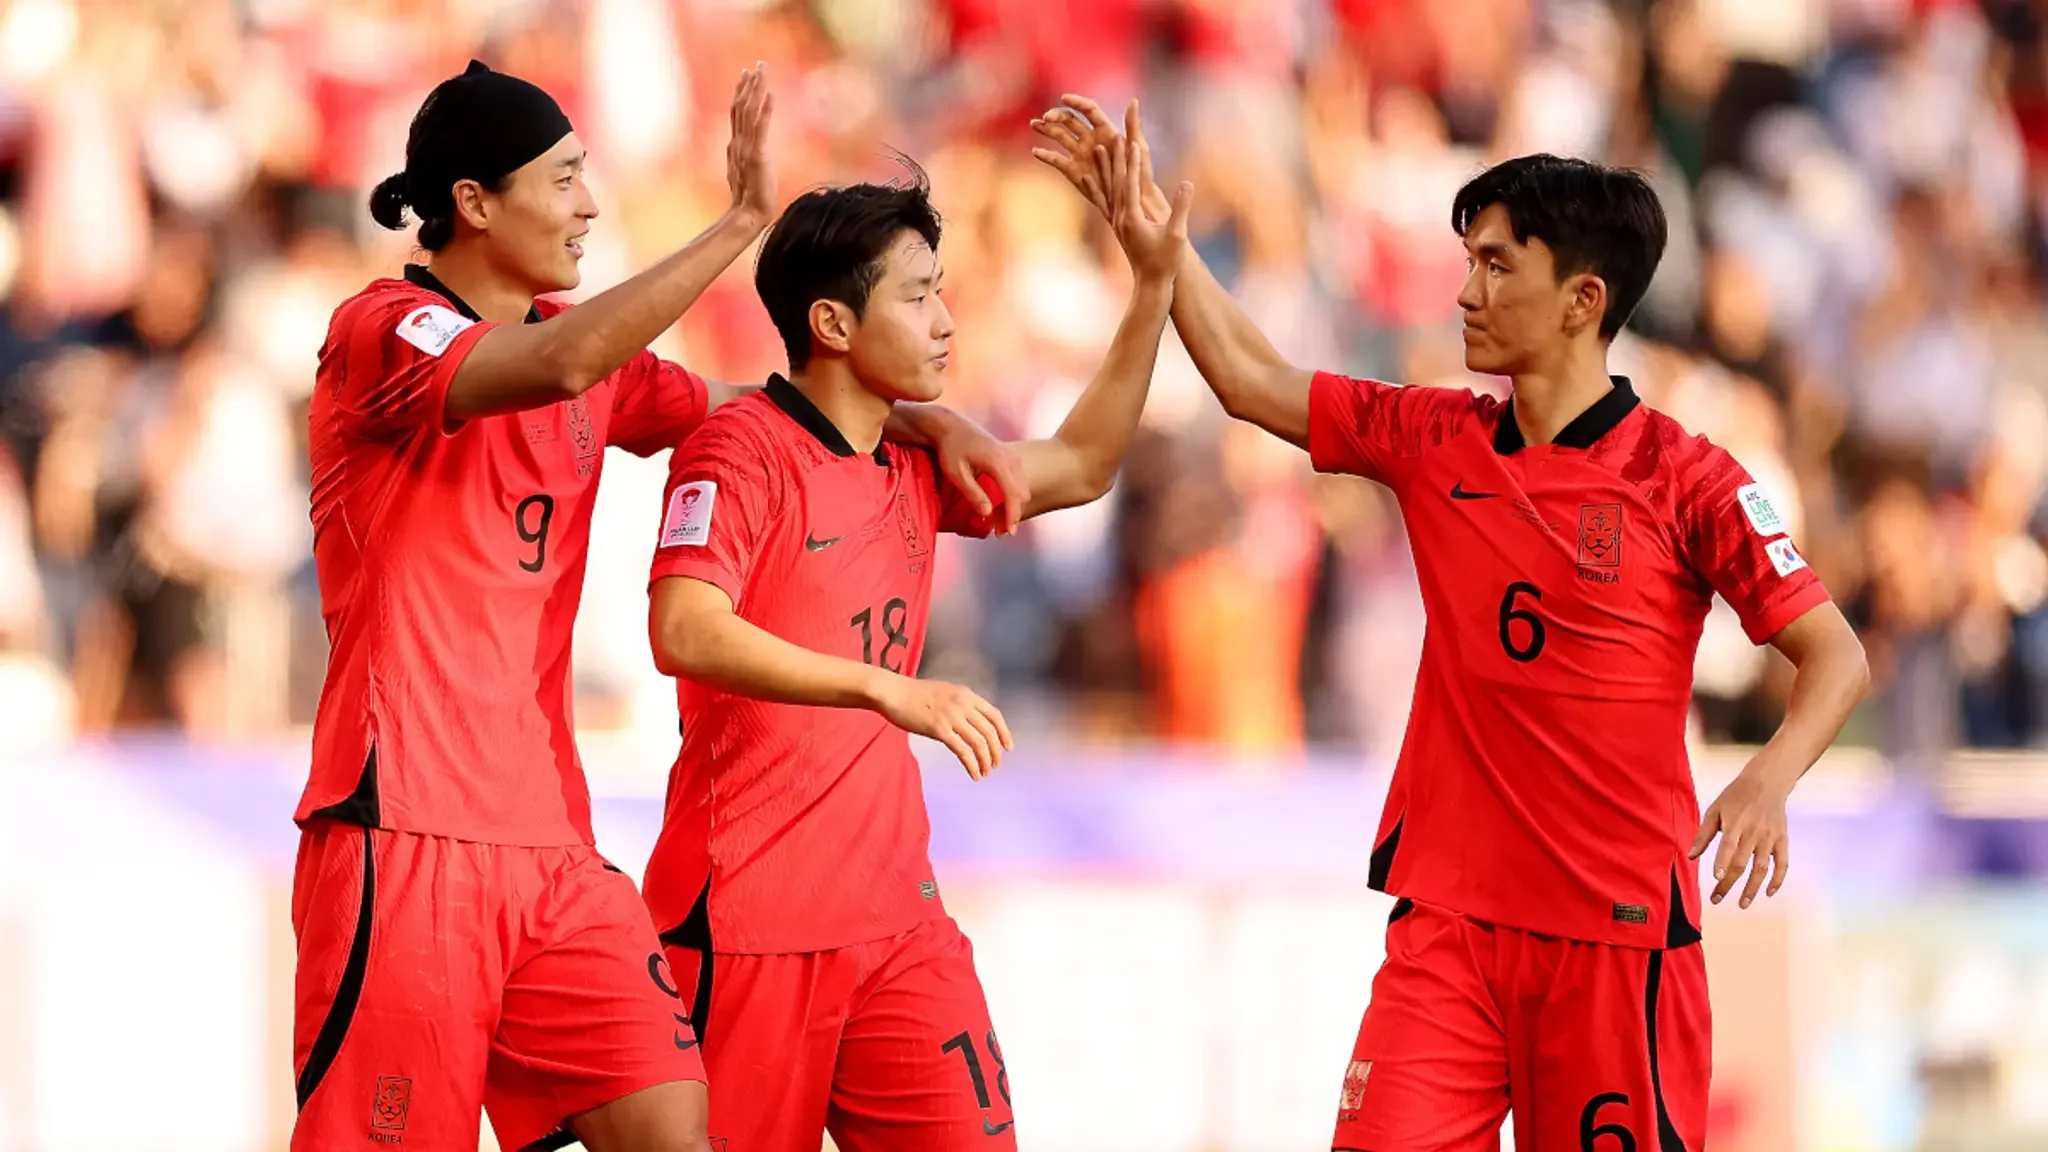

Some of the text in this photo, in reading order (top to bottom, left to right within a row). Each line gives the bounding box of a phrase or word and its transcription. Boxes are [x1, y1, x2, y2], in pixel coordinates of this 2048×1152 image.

[515, 494, 554, 573] 9
[1577, 568, 1620, 584] KOREA
[850, 597, 908, 674] 18
[1499, 581, 1545, 662] 6
[368, 1131, 402, 1144] KOREA
[1581, 1092, 1636, 1152] 6
